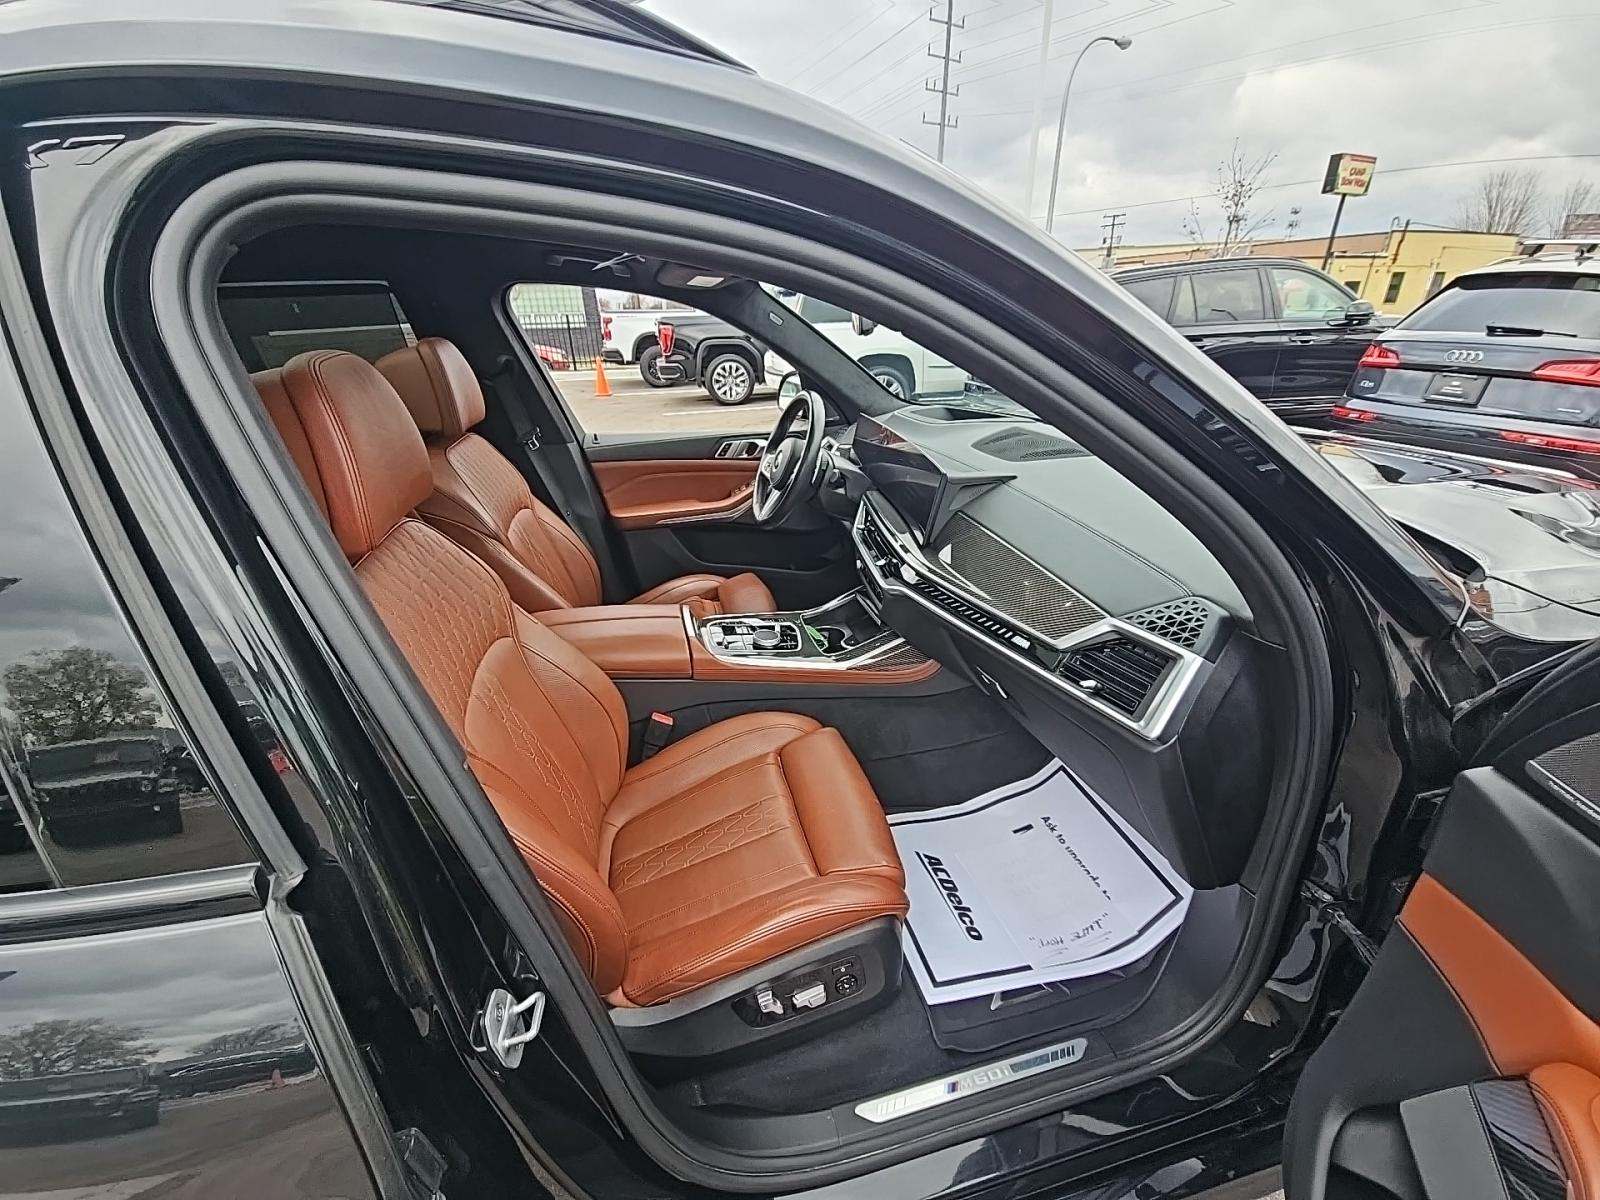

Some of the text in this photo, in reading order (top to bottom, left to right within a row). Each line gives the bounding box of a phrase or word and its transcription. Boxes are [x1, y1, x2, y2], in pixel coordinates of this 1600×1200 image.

[1040, 816, 1058, 833] Ask
[1056, 833, 1066, 844] to
[922, 853, 983, 941] ACDelco
